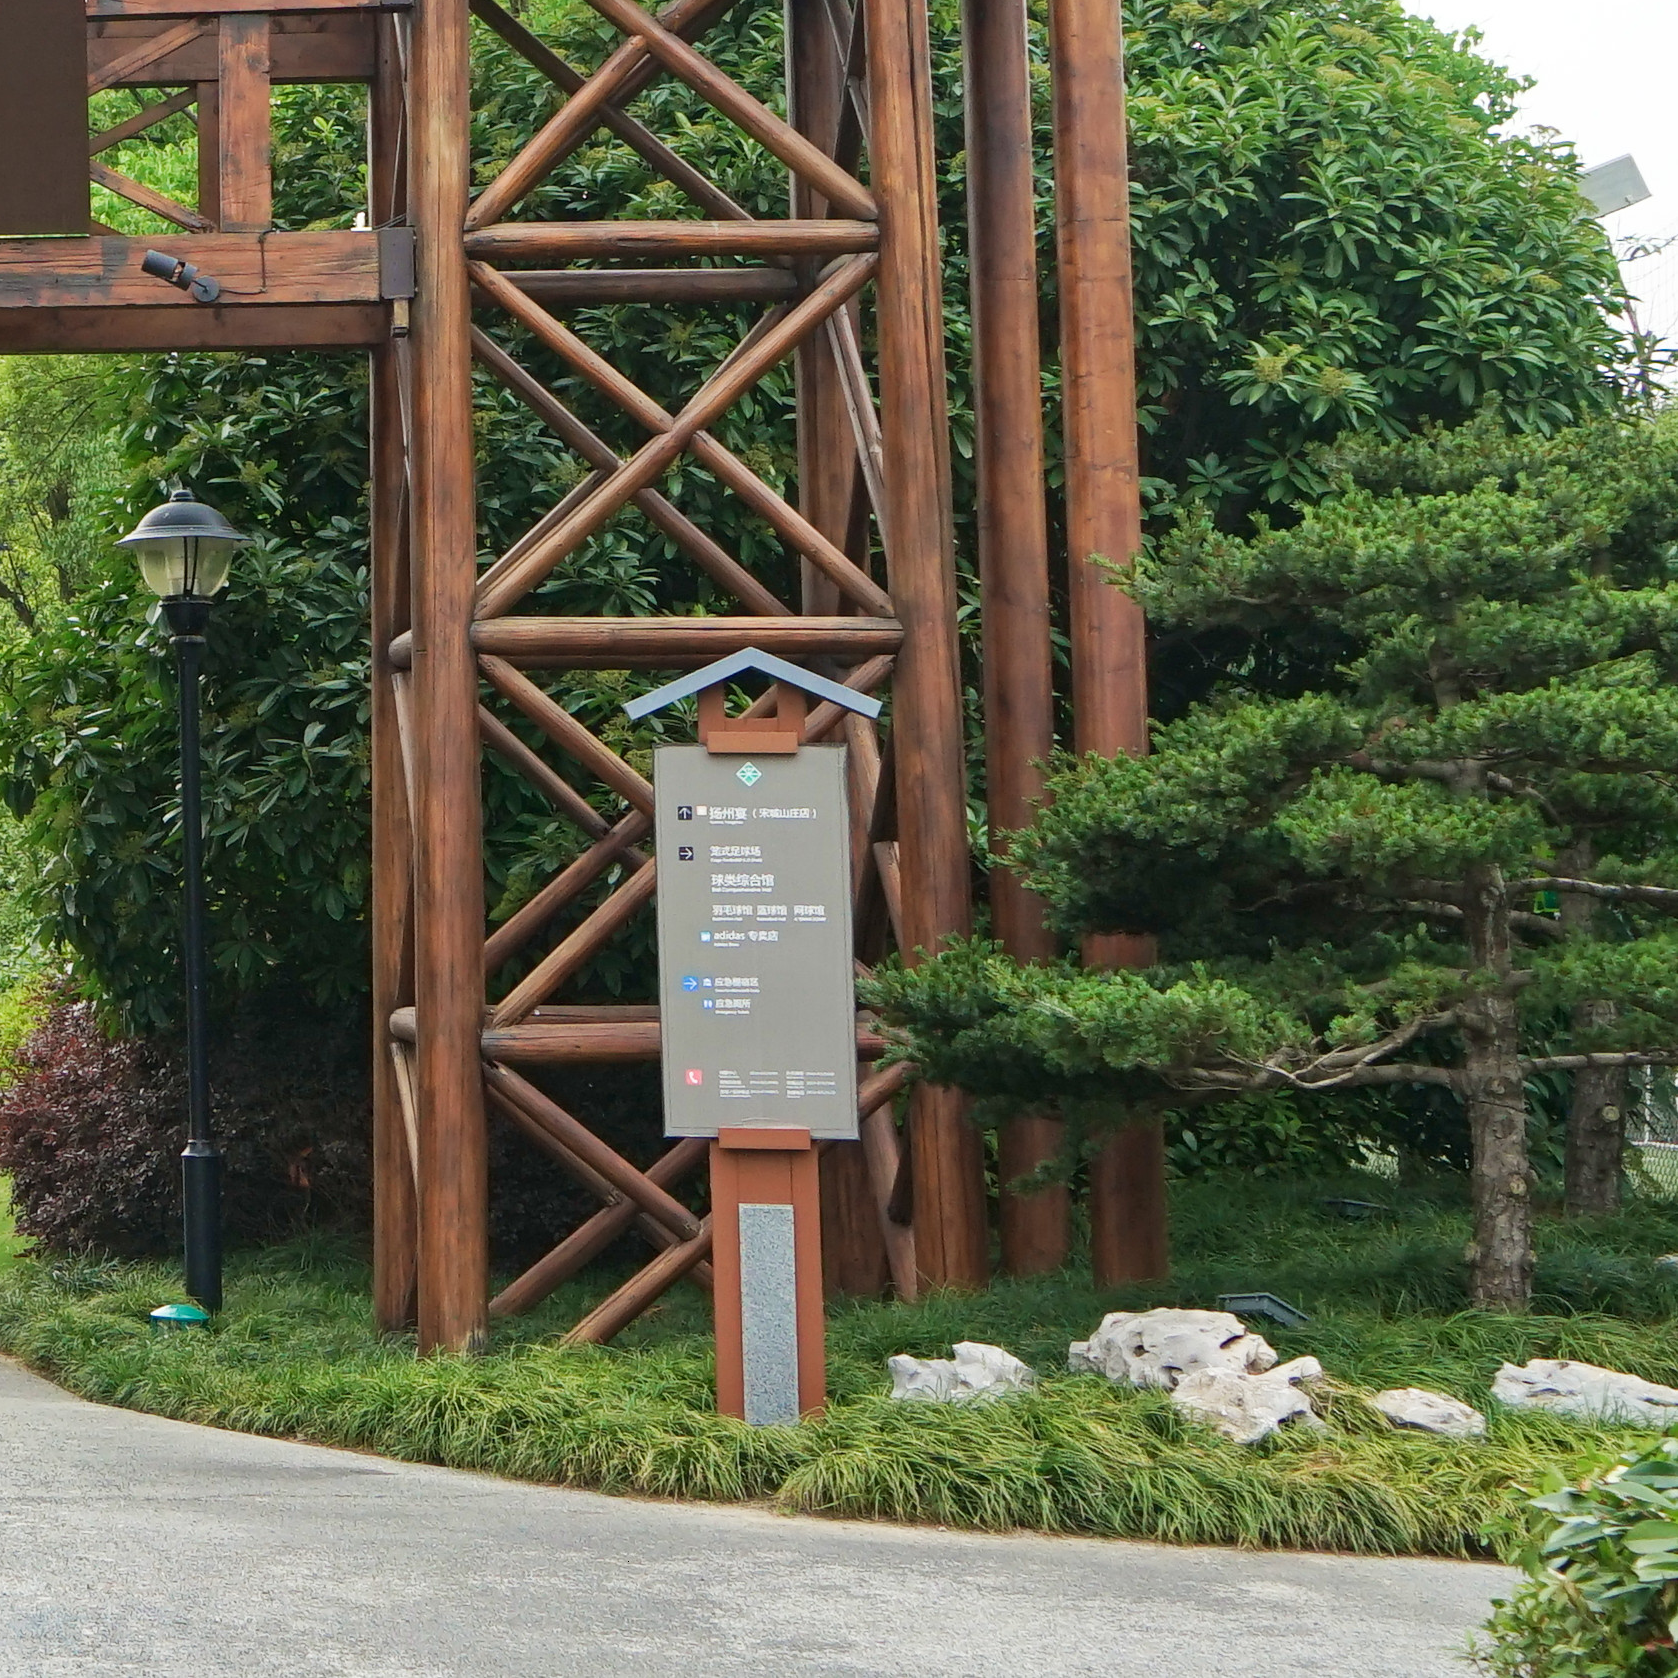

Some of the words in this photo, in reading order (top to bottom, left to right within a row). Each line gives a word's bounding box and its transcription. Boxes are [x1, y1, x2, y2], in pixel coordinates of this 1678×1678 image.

[710, 873, 775, 887] 球类综合馆
[713, 930, 746, 941] adidas
[747, 930, 779, 942] 专卖店
